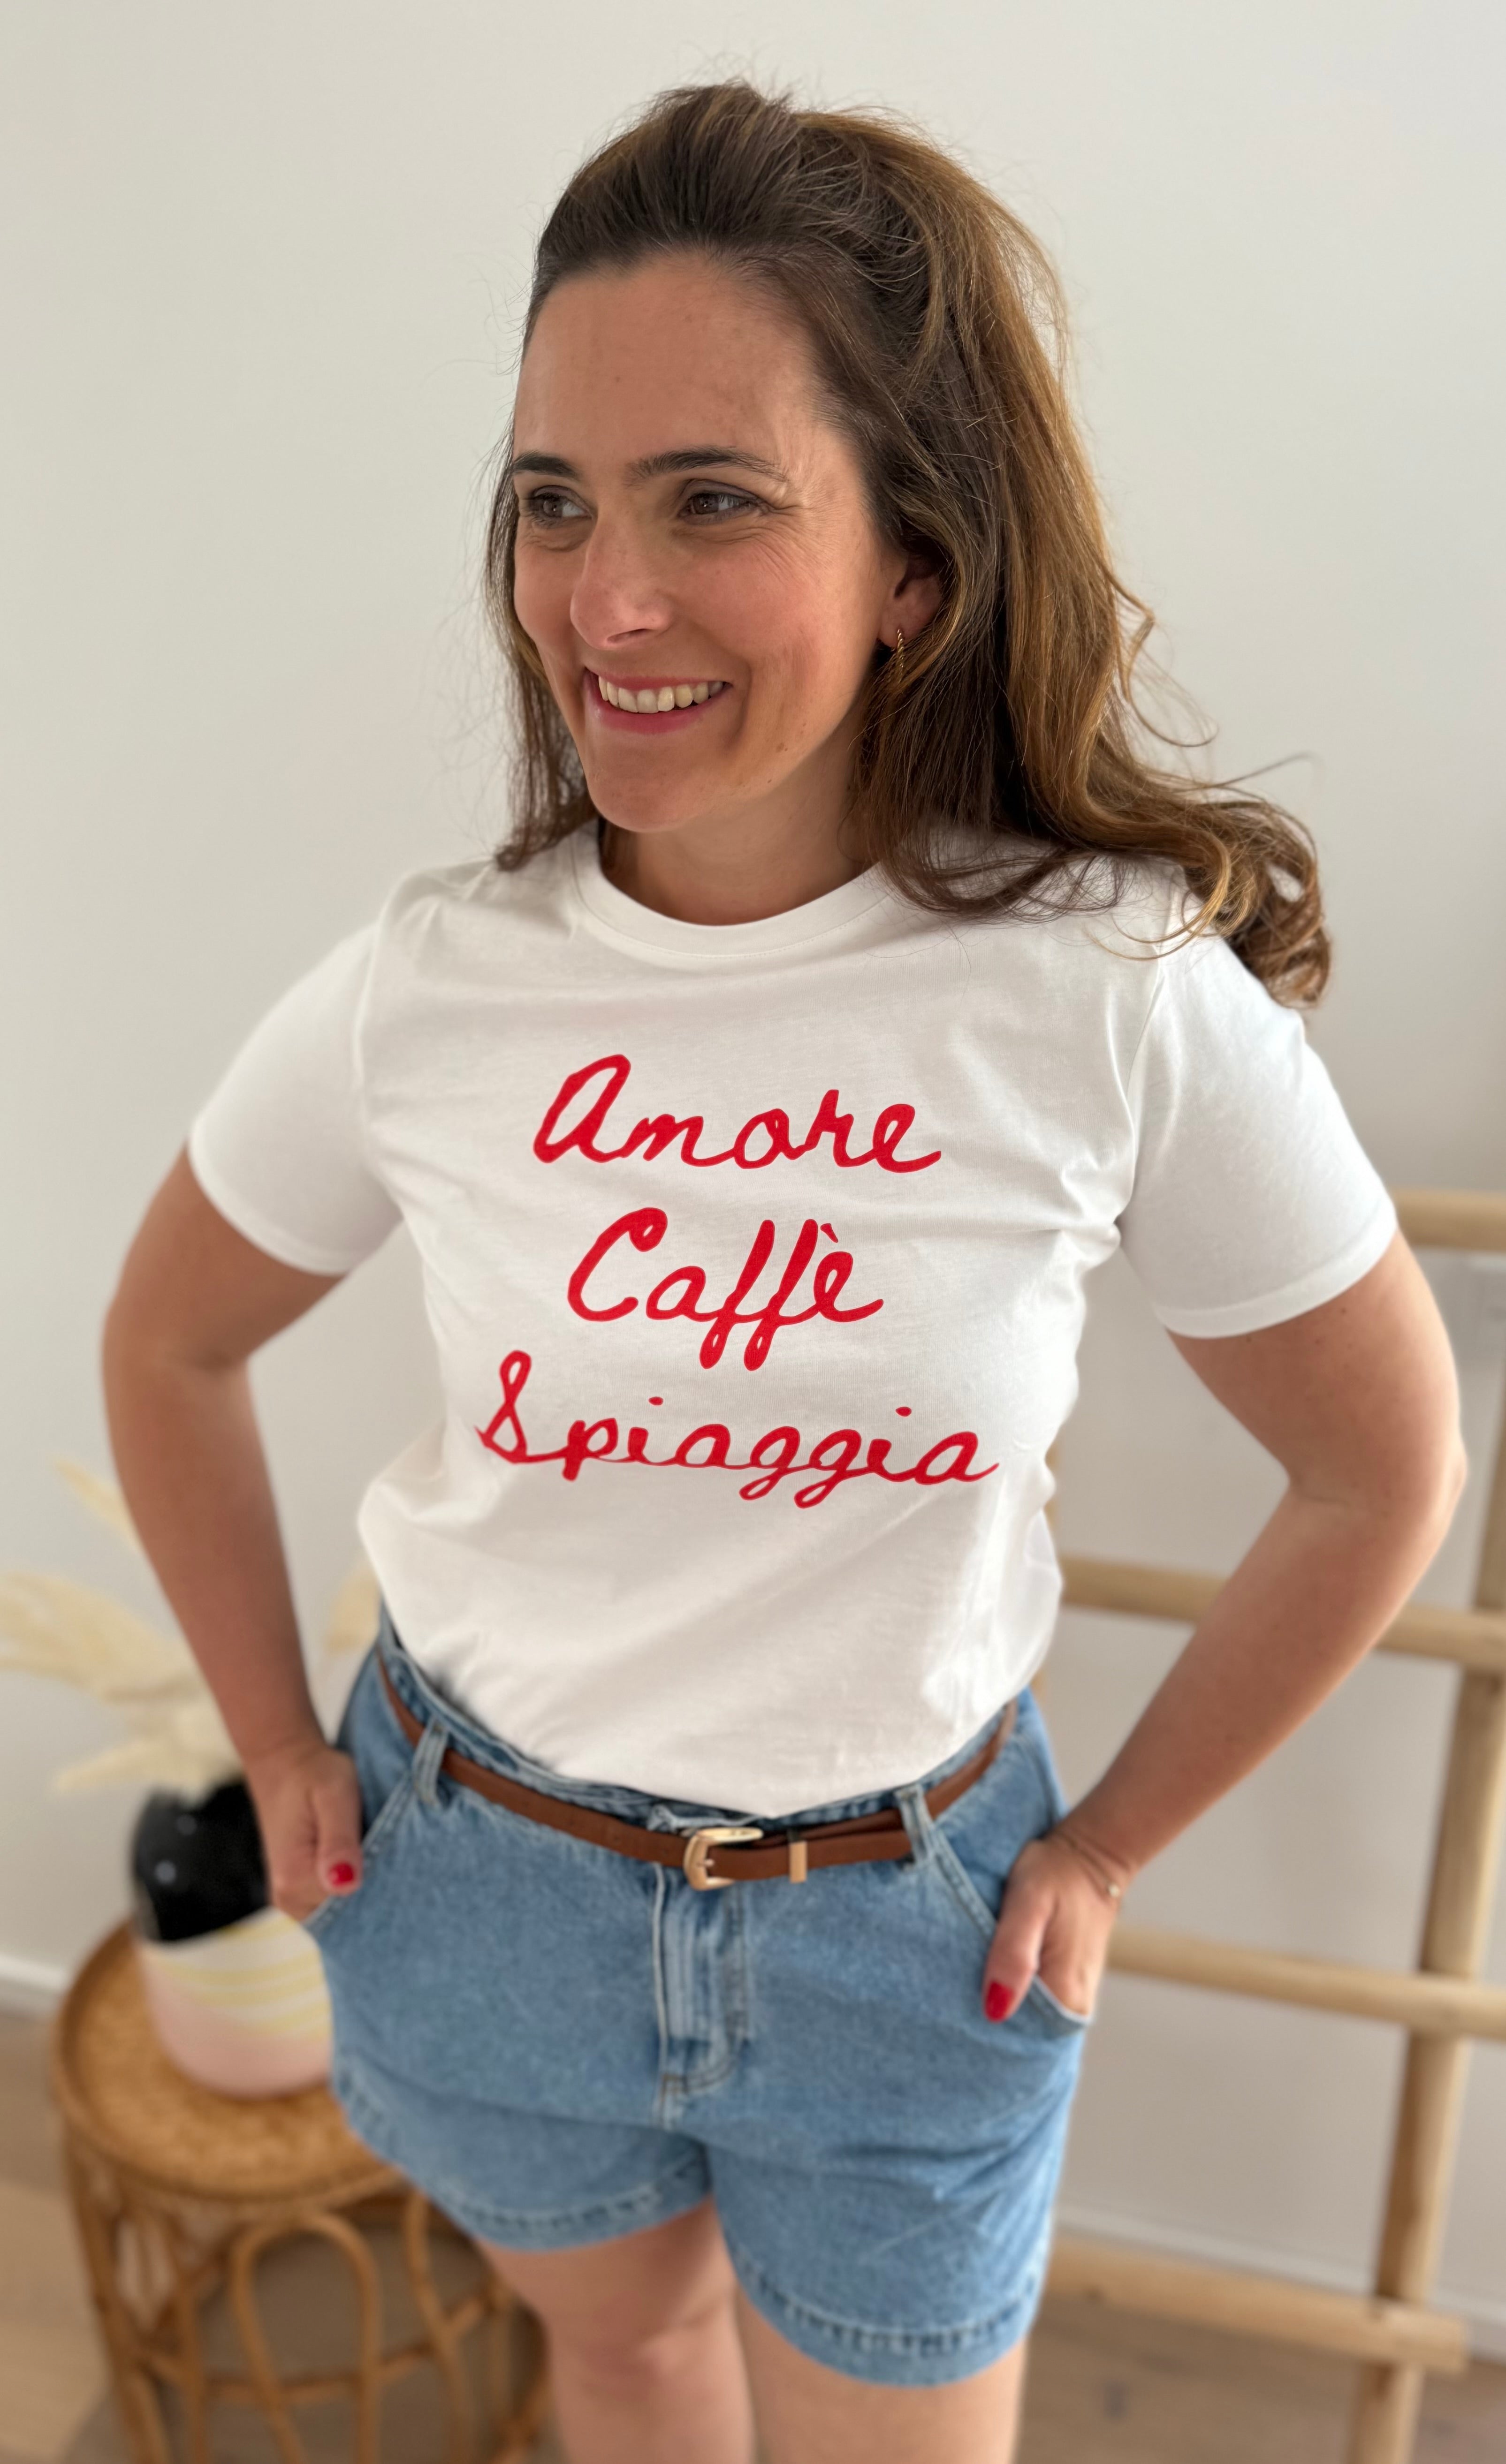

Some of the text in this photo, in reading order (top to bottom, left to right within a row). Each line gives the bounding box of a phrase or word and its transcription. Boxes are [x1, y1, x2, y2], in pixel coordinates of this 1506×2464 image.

[533, 1054, 942, 1174] Amore
[567, 1207, 884, 1371] Caffè
[475, 1350, 999, 1509] Spiaggia
